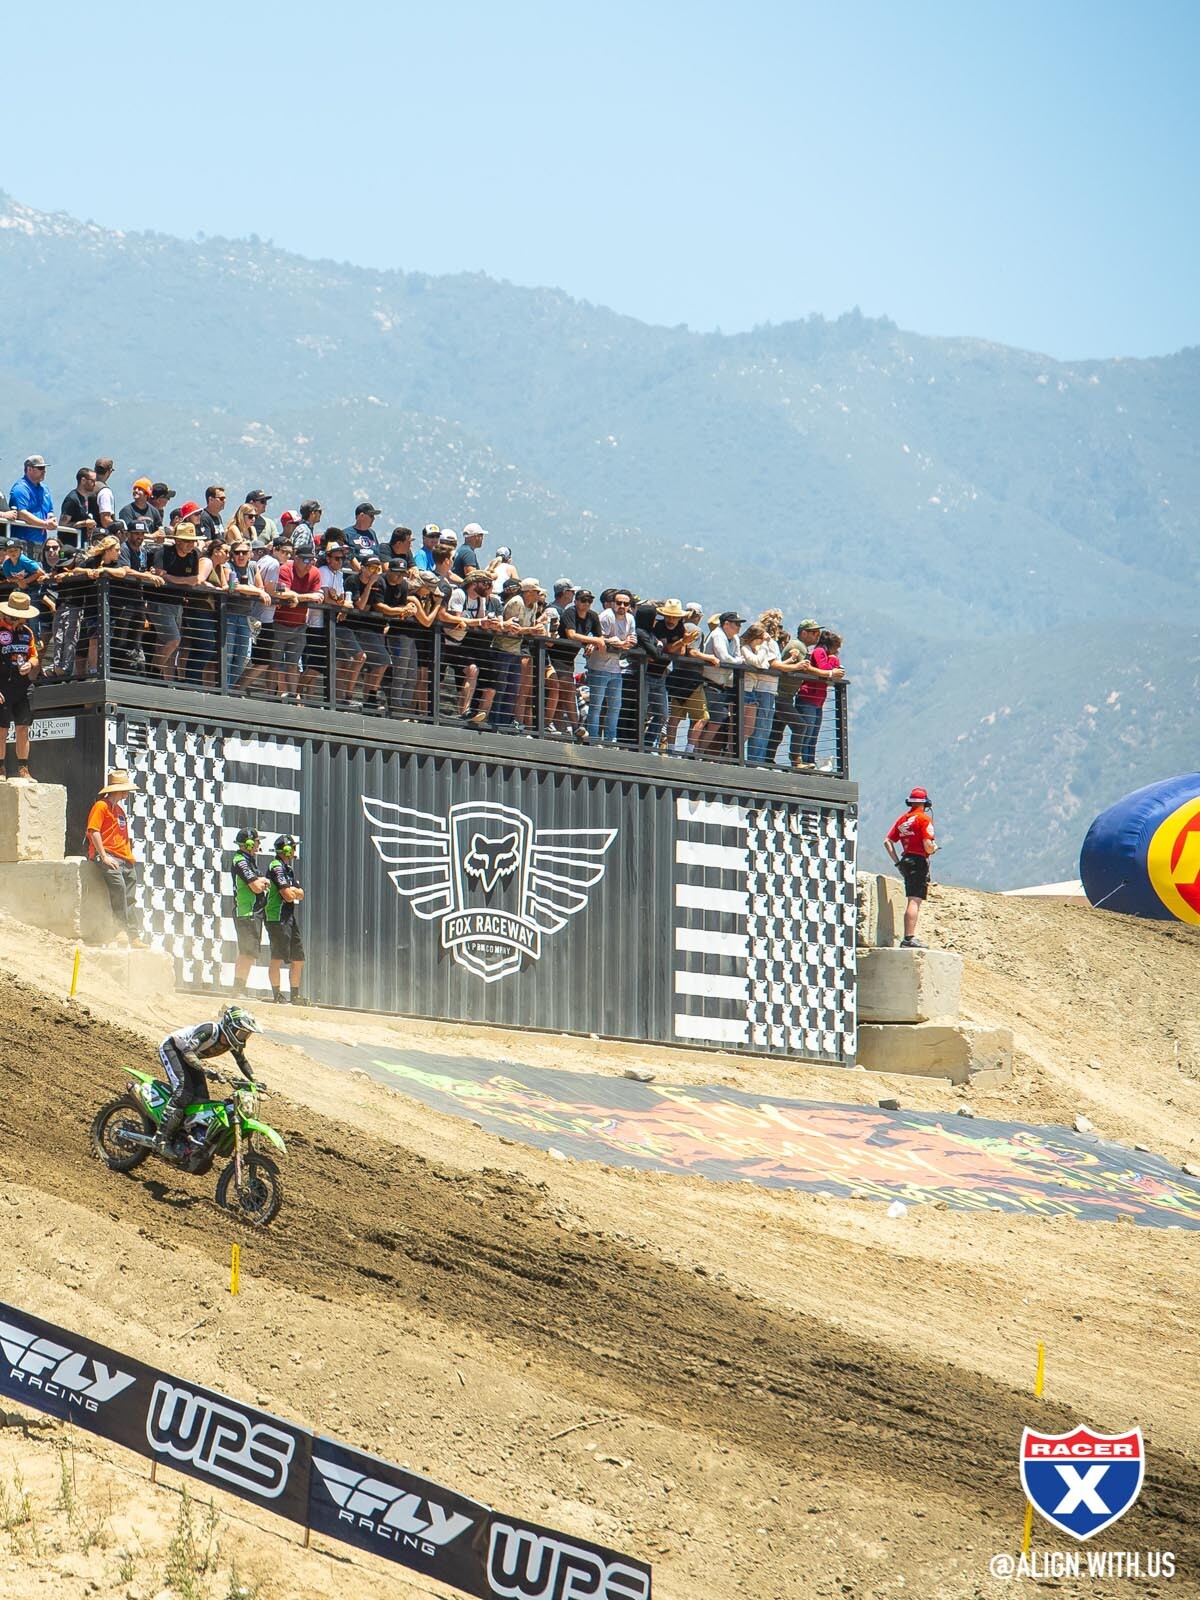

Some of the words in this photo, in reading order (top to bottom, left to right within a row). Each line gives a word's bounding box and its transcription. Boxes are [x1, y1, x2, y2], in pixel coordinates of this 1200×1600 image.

[449, 916, 472, 939] FOX
[475, 915, 535, 948] RACEWAY
[0, 1339, 137, 1402] FLY
[9, 1367, 99, 1413] RACING
[148, 1380, 296, 1499] WPS
[323, 1479, 474, 1546] FLY
[338, 1509, 436, 1557] RACING
